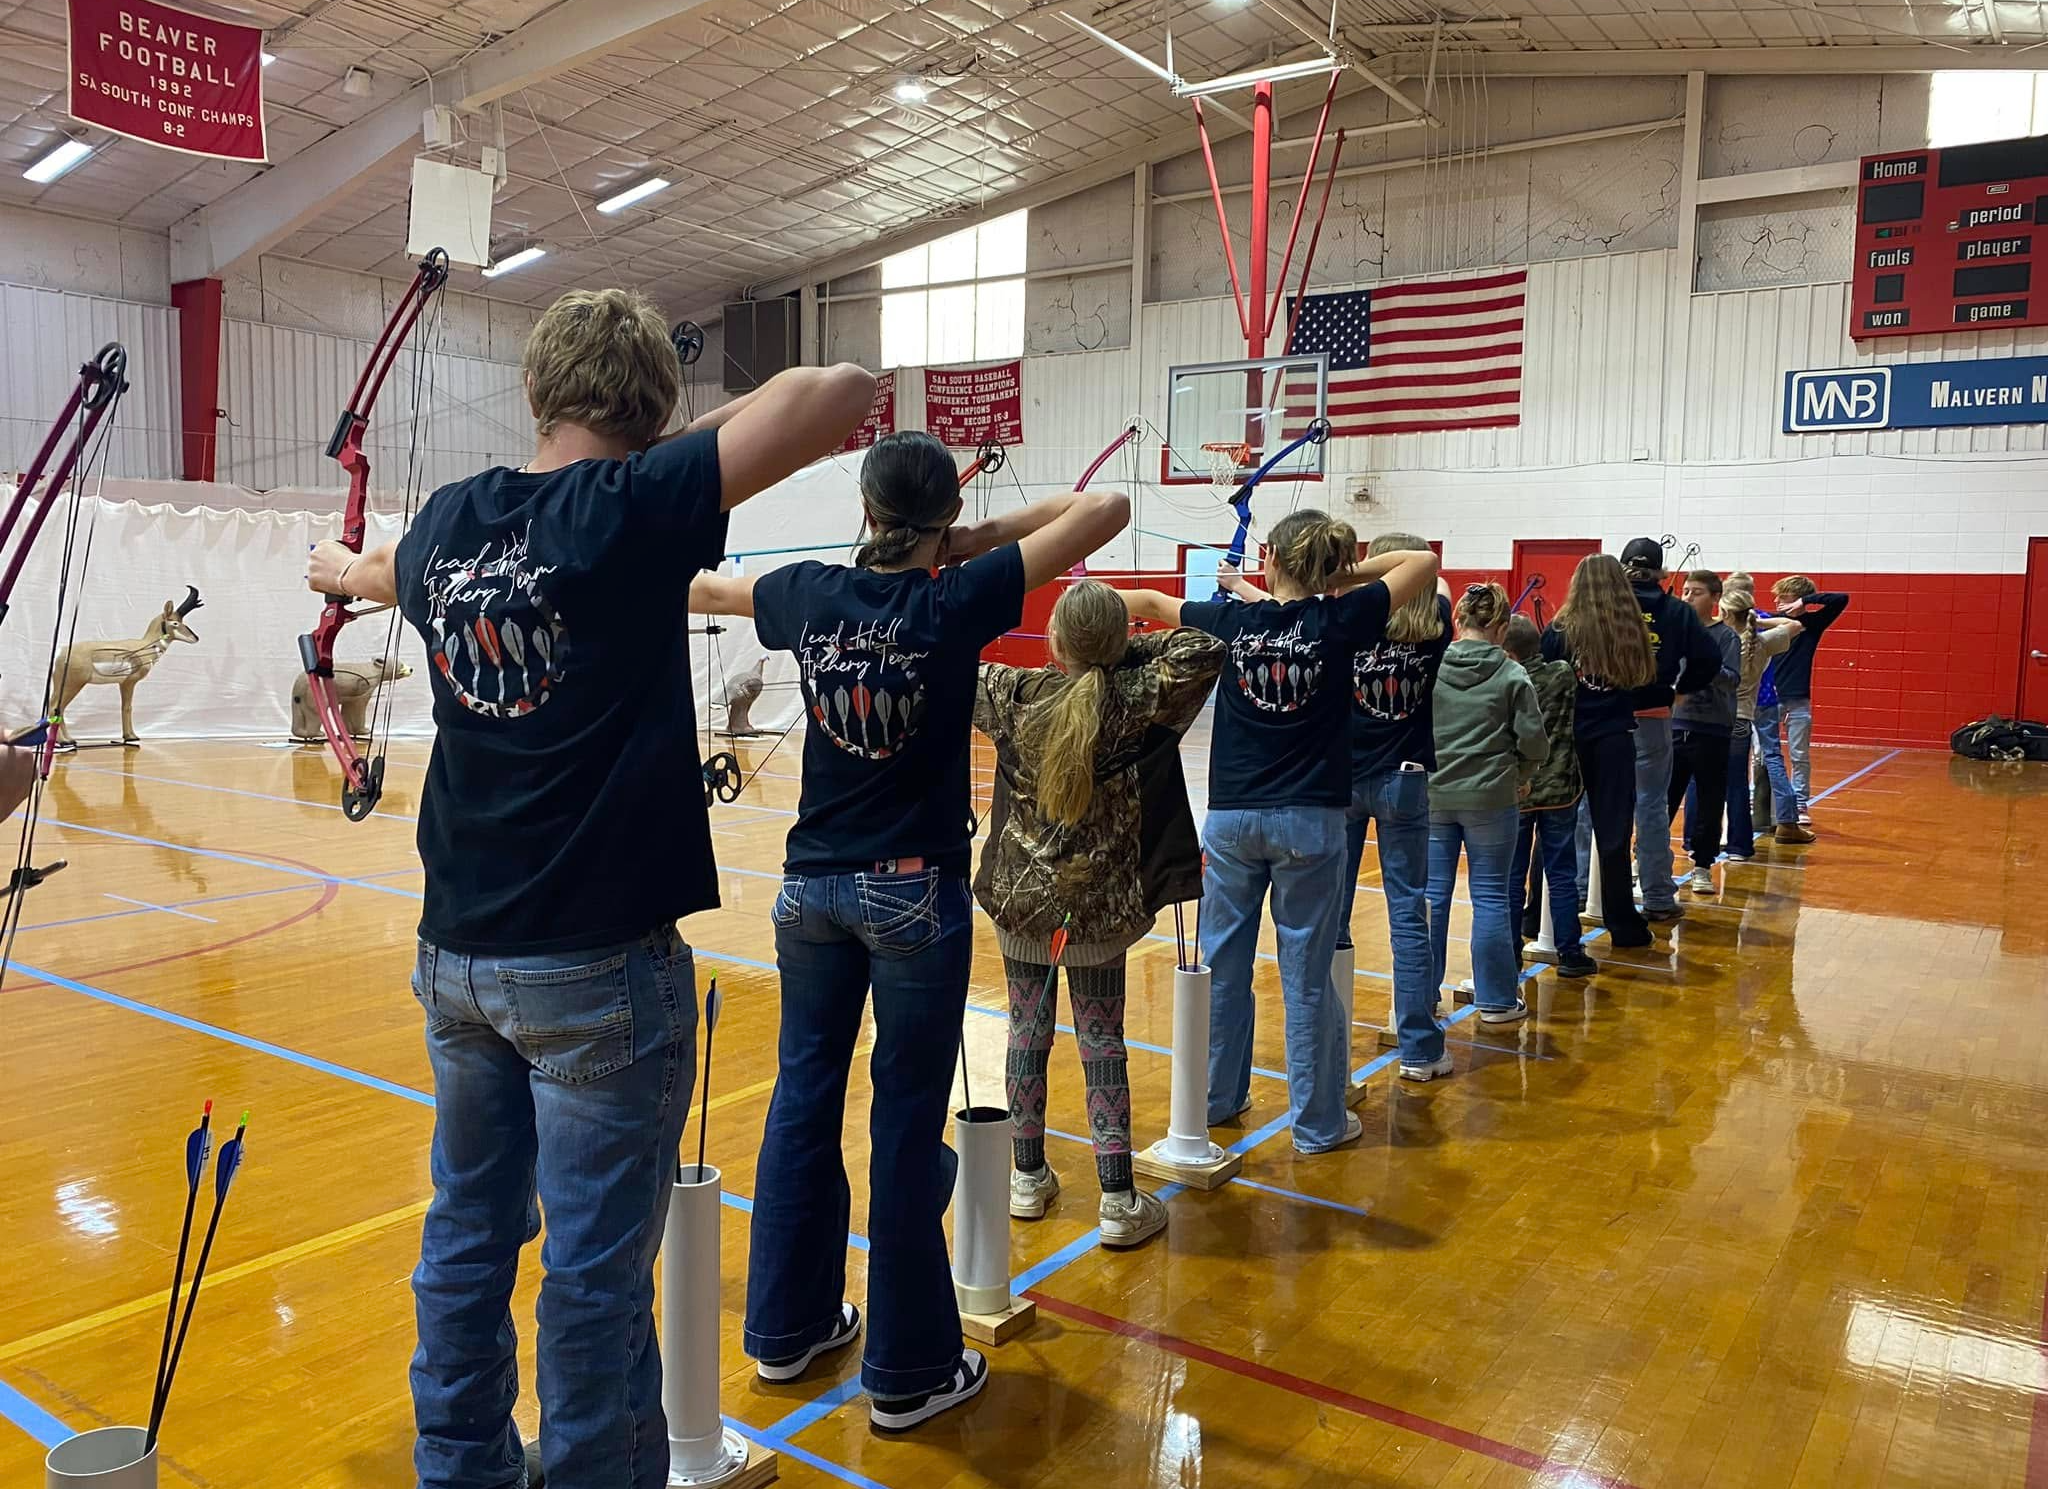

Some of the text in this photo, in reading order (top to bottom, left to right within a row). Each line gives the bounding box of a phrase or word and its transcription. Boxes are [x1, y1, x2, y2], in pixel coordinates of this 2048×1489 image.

[119, 11, 217, 57] BEAVER
[99, 32, 236, 88] FOOTBALL
[150, 75, 192, 98] 1992
[101, 82, 151, 109] SOUTH
[158, 99, 196, 120] CONF.
[201, 109, 254, 128] CHAMPS
[1873, 161, 1917, 179] Home
[1970, 203, 2022, 228] period
[1967, 239, 2022, 260] player
[1872, 311, 1902, 326] won
[1970, 304, 2011, 322] game
[929, 378, 1015, 395] CONFERENCE CHAMPIONS
[949, 375, 972, 385] SOUTH
[975, 369, 1012, 383] BASEBALL
[927, 388, 1019, 405] CONFERENCE TOURNAMENT
[1802, 379, 1877, 421] MNB
[950, 404, 991, 416] CHAMPIONS
[964, 415, 991, 426] RECORD
[423, 542, 492, 586] Lead
[800, 617, 903, 652] Lead Hill
[802, 643, 928, 681] Archery Team
